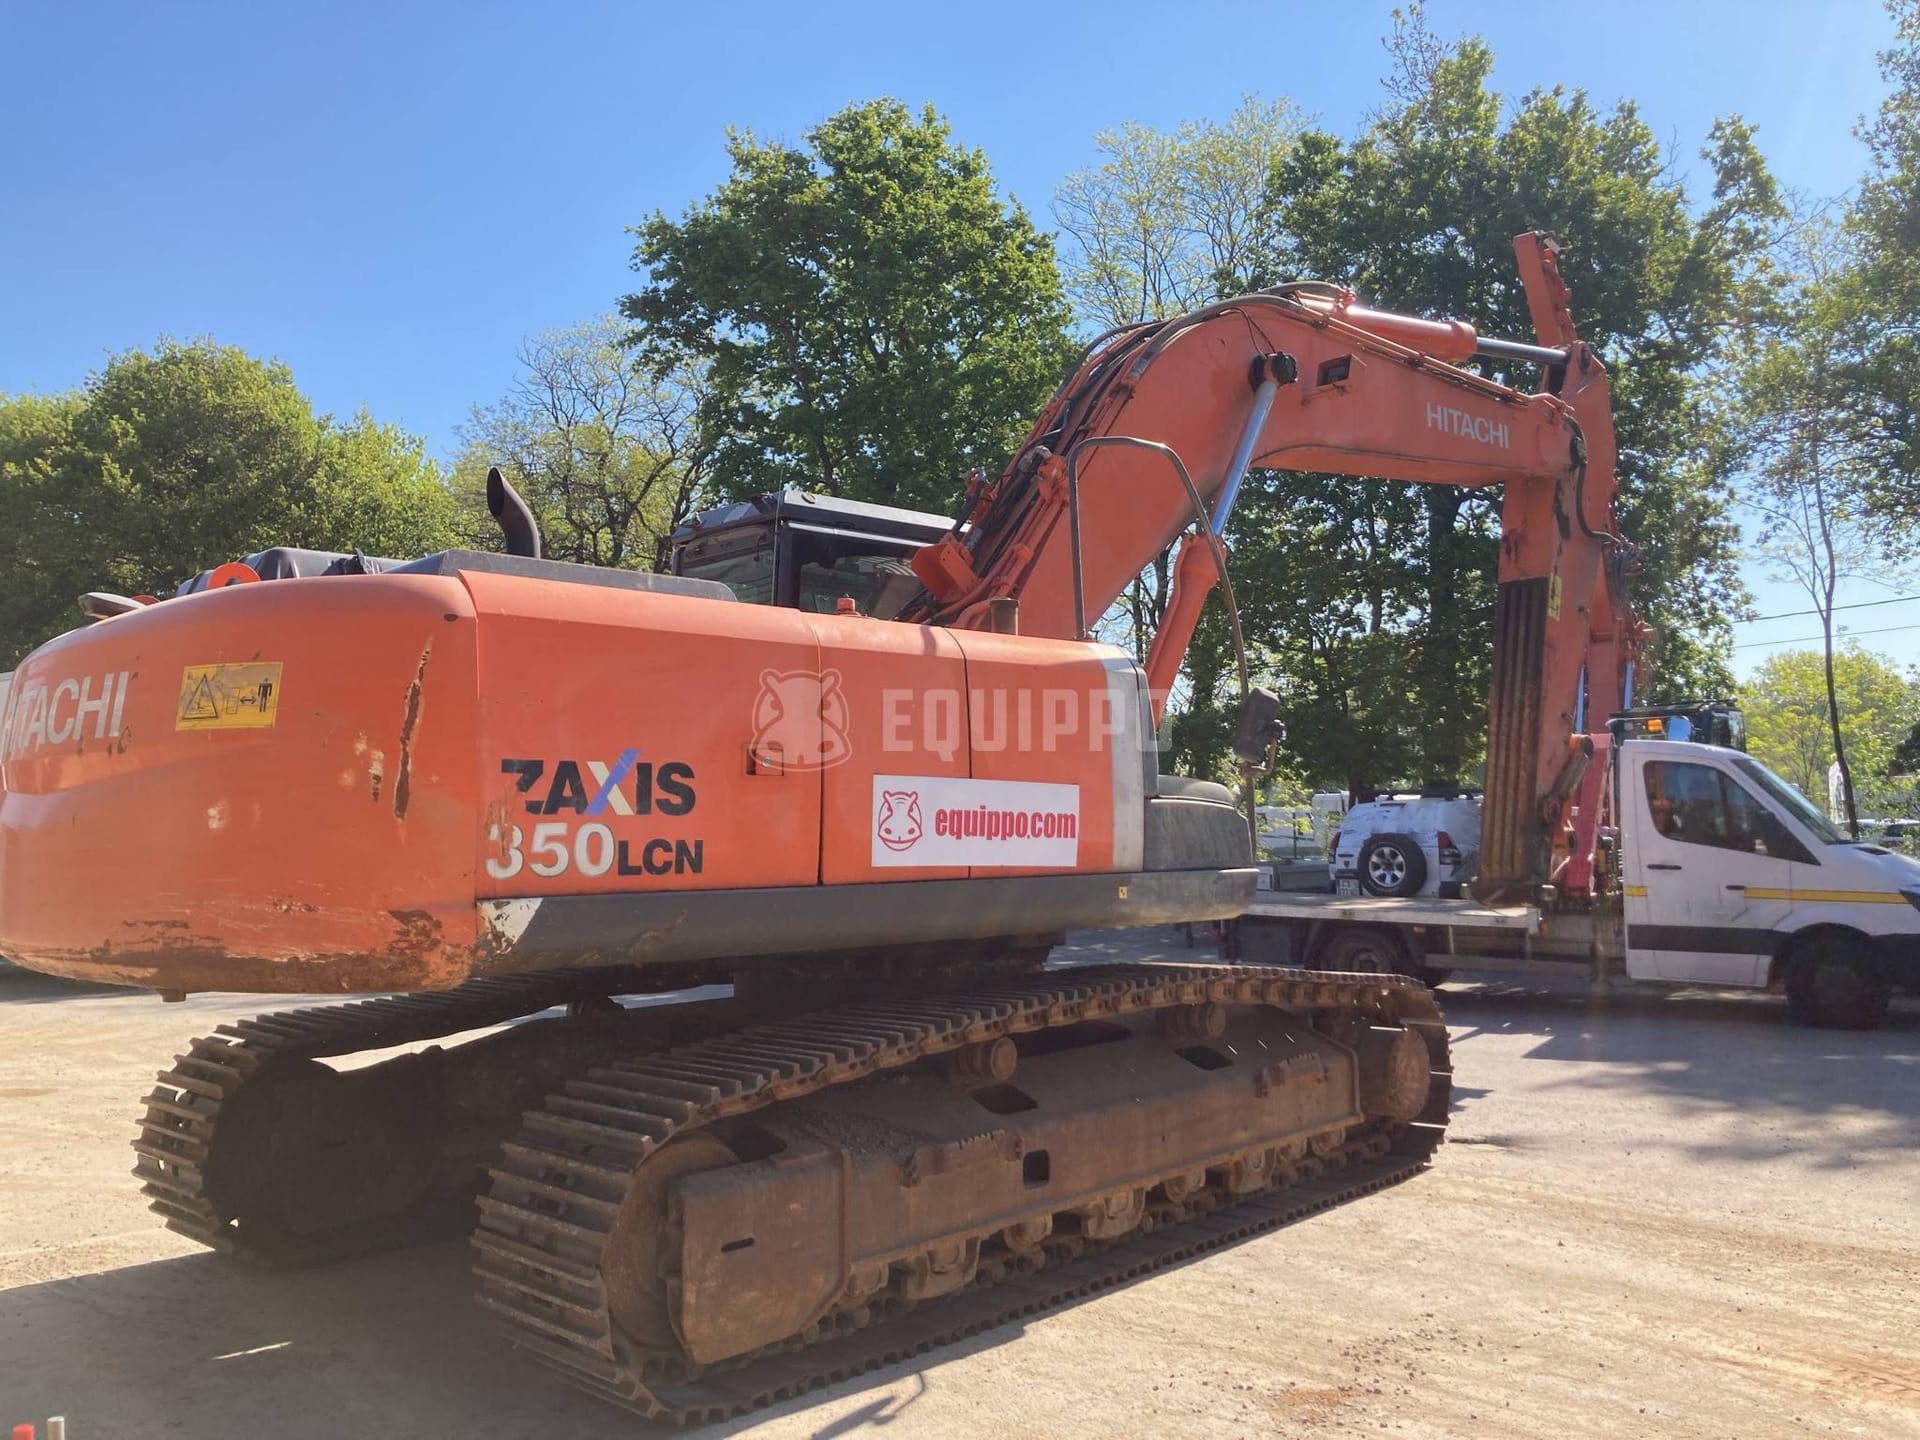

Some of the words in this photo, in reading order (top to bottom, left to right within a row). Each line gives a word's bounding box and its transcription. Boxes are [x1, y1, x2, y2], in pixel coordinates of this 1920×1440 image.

[1426, 402, 1510, 449] HITACHI
[501, 748, 696, 816] ZAXIS
[934, 805, 1076, 841] equippo.com
